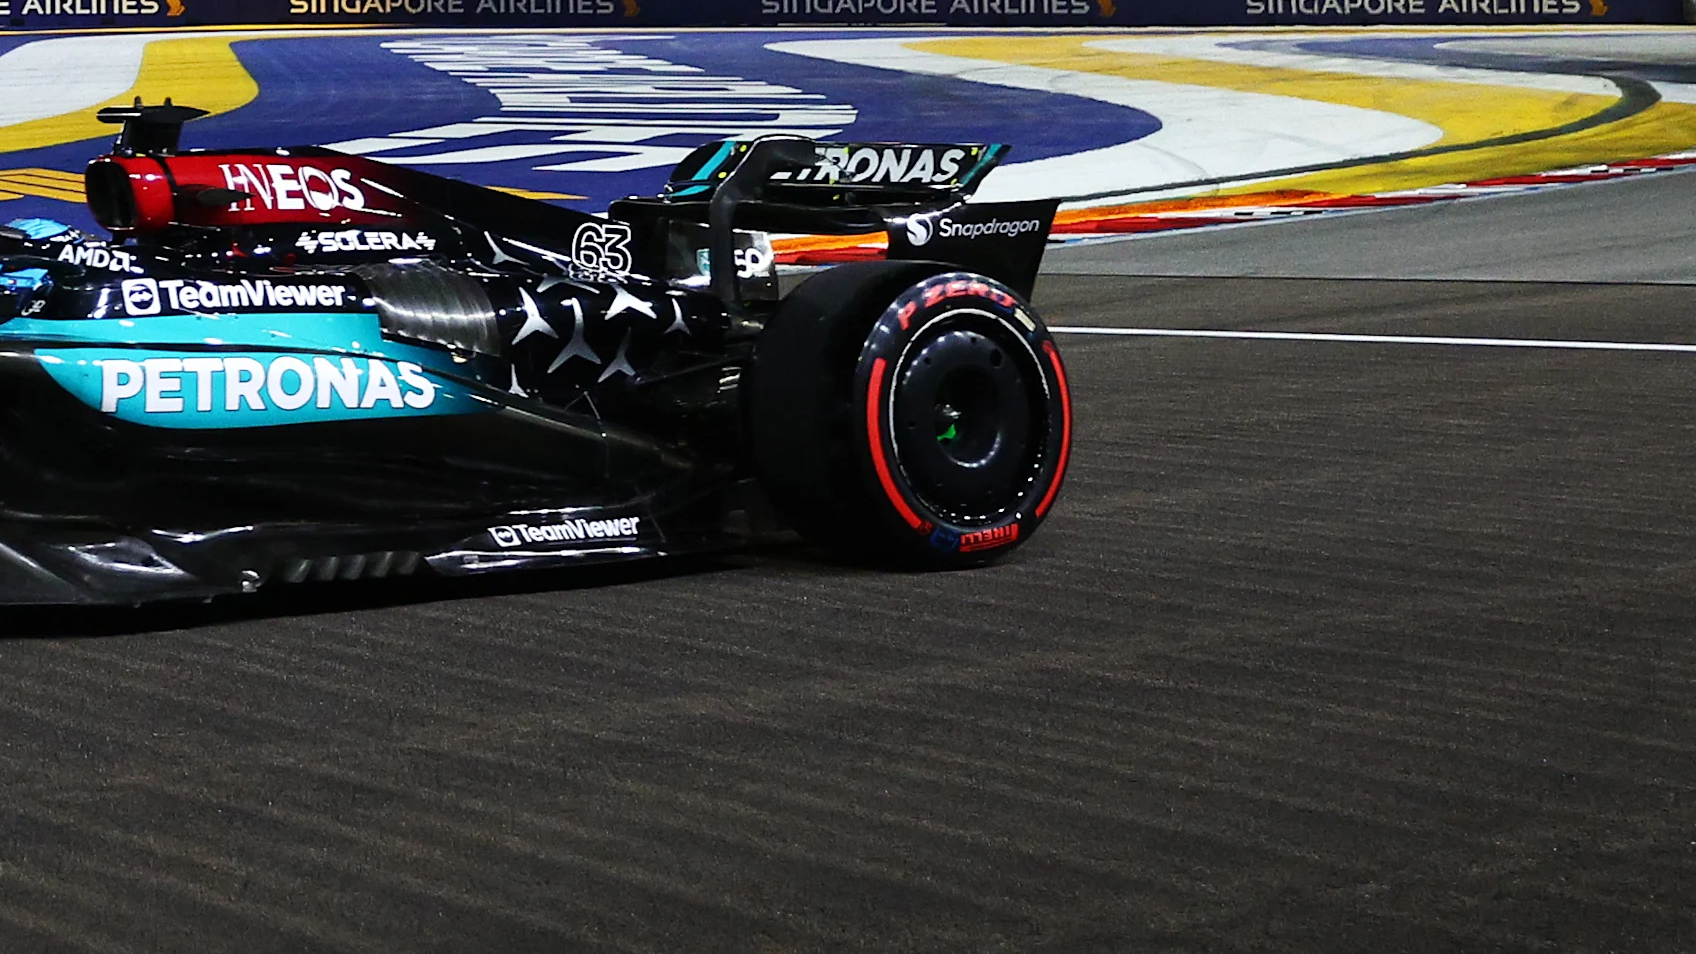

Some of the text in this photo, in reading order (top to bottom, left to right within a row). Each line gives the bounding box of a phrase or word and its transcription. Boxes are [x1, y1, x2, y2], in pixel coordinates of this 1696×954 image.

[218, 163, 367, 213] INEOS
[316, 230, 417, 252] SOLERA
[938, 217, 1041, 239] Snapdragon
[57, 243, 111, 269] AMD
[571, 222, 633, 277] 63
[159, 278, 346, 310] TeamViewer
[100, 356, 437, 414] PETRONAS
[514, 516, 641, 543] TeamViewer
